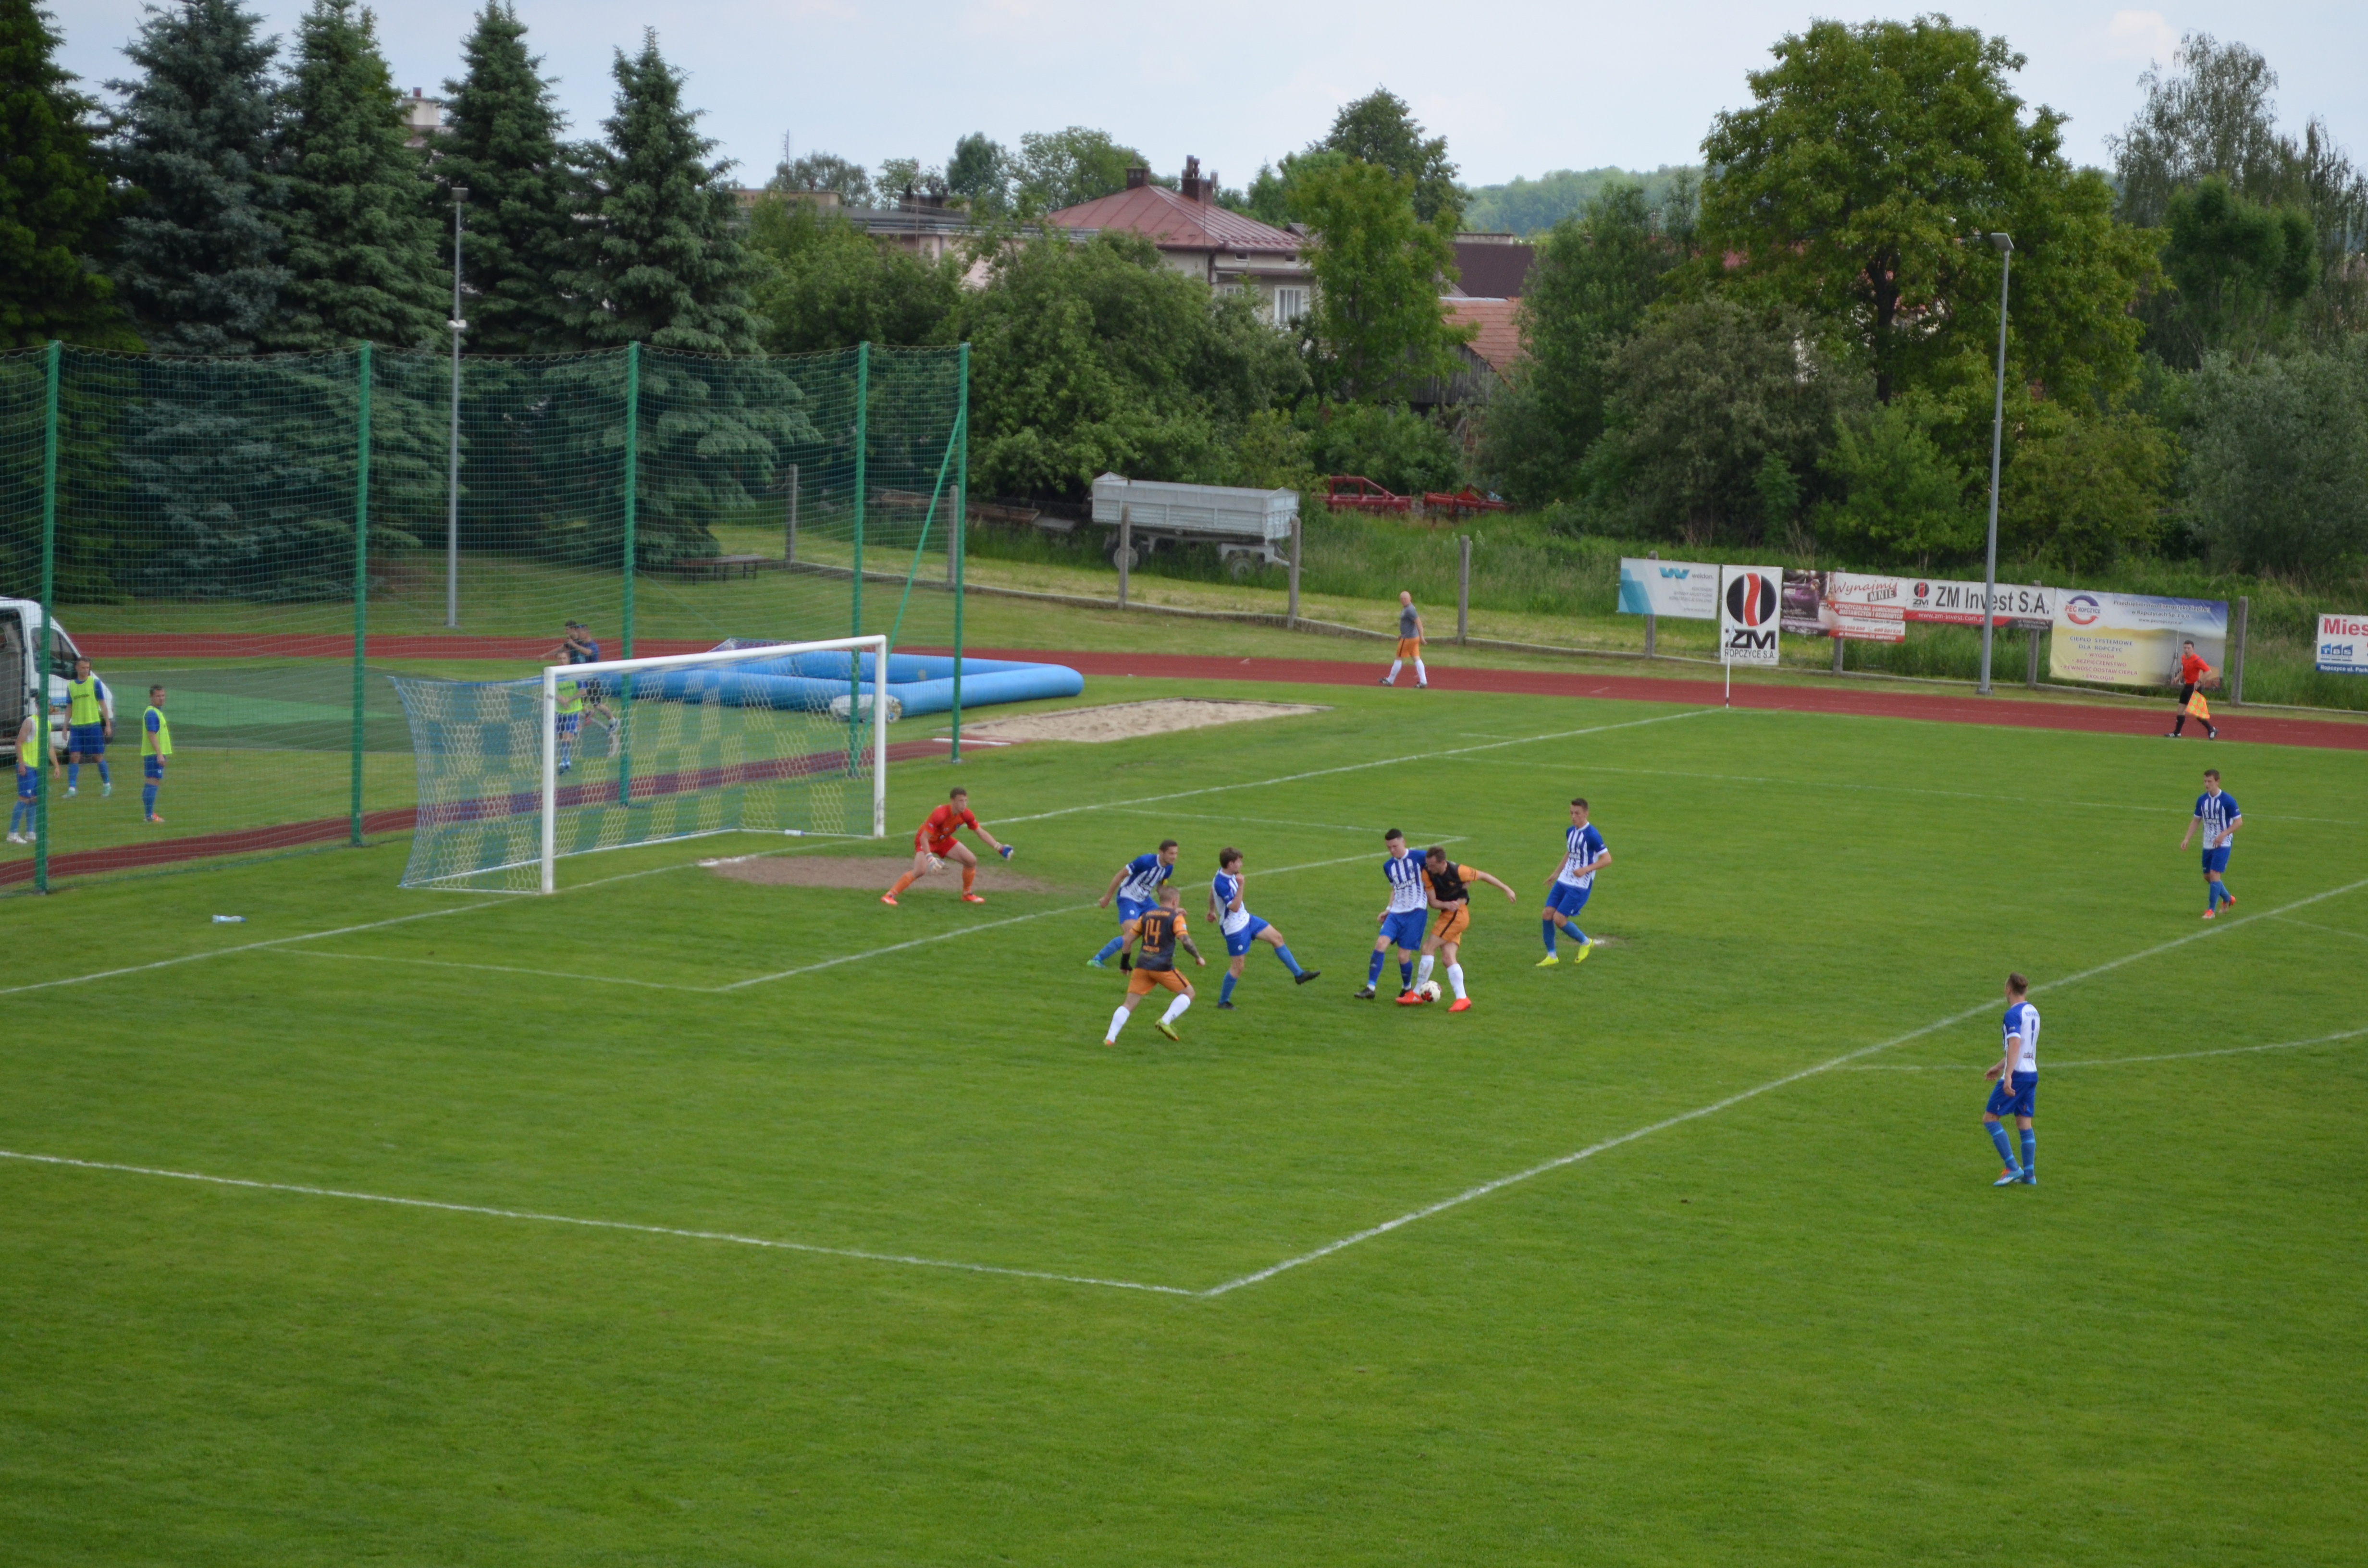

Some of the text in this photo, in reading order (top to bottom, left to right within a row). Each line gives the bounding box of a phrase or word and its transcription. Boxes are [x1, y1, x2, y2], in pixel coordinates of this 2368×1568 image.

[1834, 578, 1898, 595] Wynajmij
[1870, 589, 1894, 601] MNIE
[1936, 586, 1960, 608] ZM
[2019, 590, 2049, 614] S.A.
[2114, 600, 2158, 608] Przedsiębiorstwo
[2159, 602, 2187, 612] Energetyki
[1875, 612, 1904, 620] OSOBOWYCH
[1918, 612, 1985, 623] www.zm-invest.com.pl
[2324, 618, 2368, 636] Mies
[1725, 628, 1776, 649] ZM
[2095, 637, 2133, 646] SYSTEMOWE
[1725, 649, 1776, 659] ROPCZYCE S.A.
[1144, 919, 1161, 945] 14
